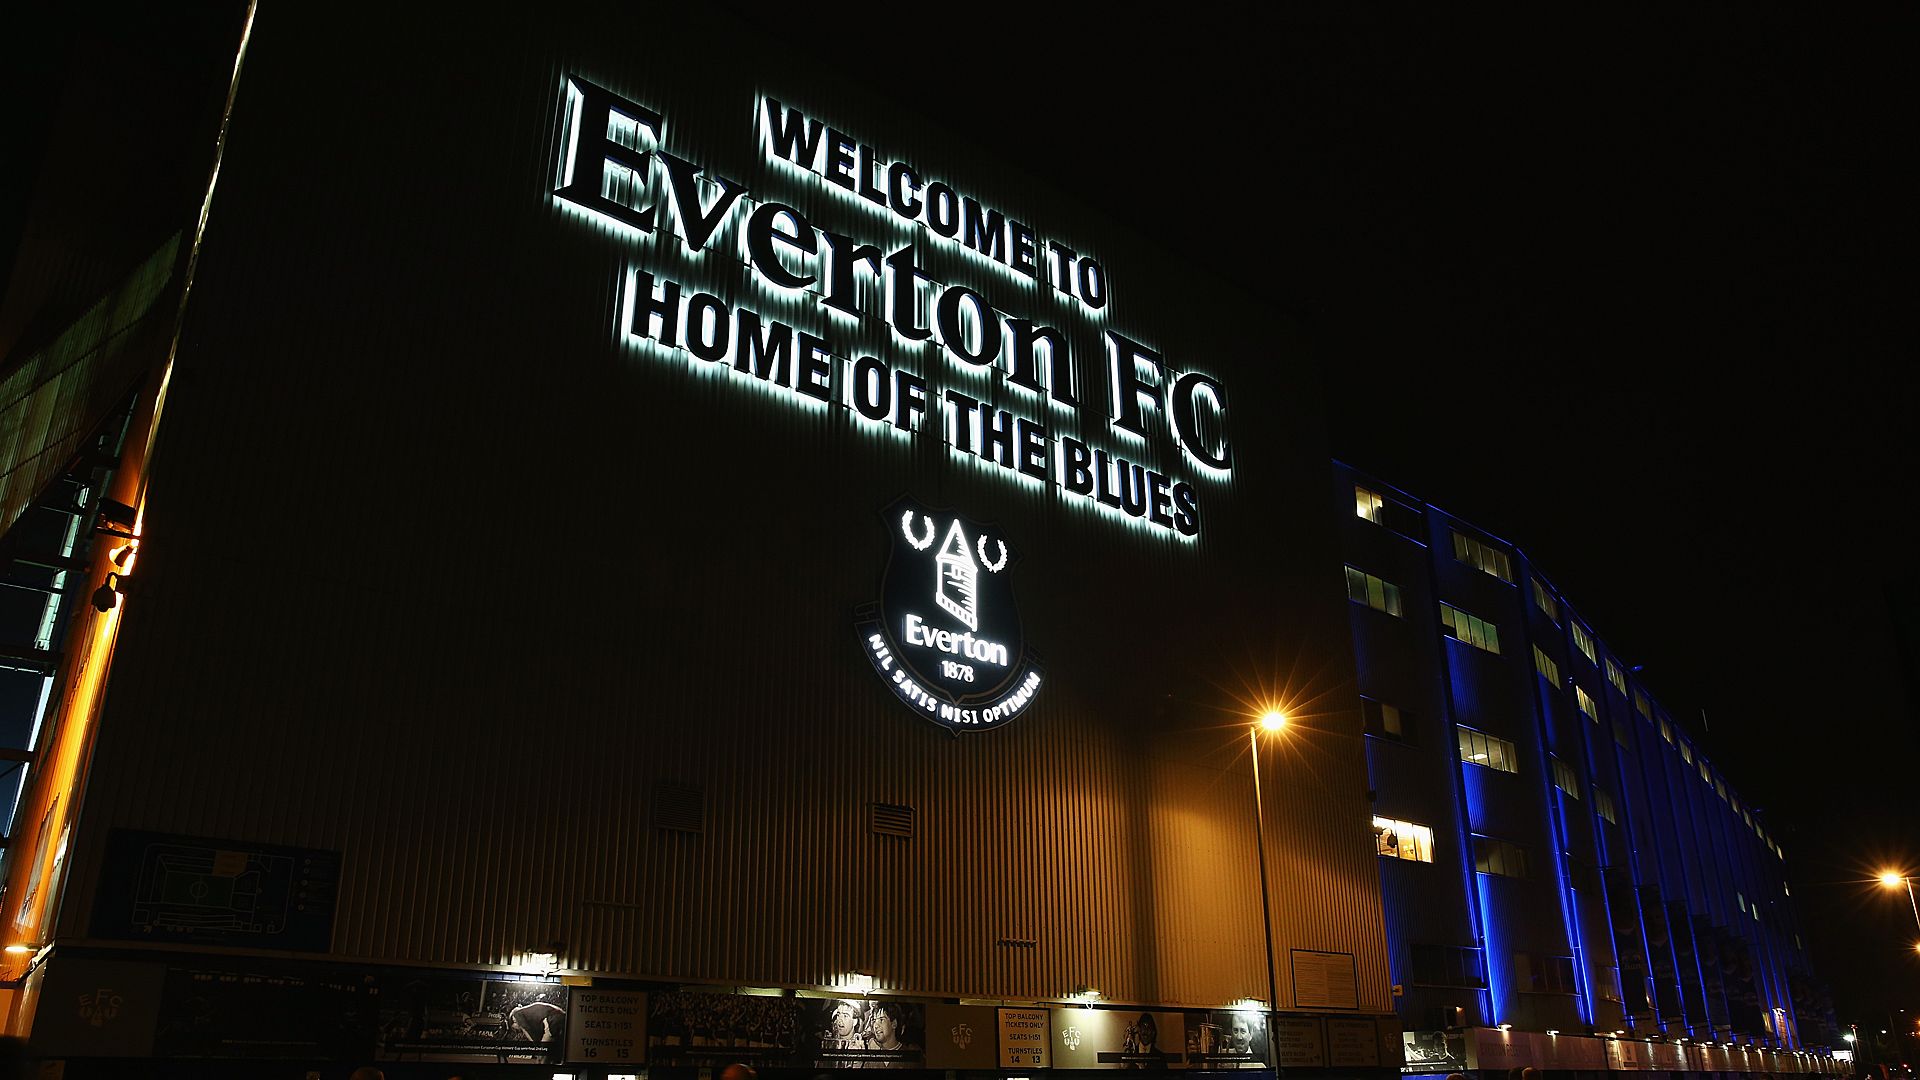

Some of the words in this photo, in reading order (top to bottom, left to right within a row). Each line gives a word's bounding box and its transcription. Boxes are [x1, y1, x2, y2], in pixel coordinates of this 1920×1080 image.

[765, 97, 1037, 280] WELCOME
[1049, 239, 1107, 309] TO
[553, 73, 1079, 410] Everton
[1106, 329, 1232, 470] FC
[631, 269, 832, 402] HOME
[852, 356, 927, 432] OF
[945, 389, 1049, 481] THE
[1062, 436, 1200, 536] BLUES
[905, 613, 1008, 666] Everton
[941, 660, 974, 682] 1878
[868, 633, 895, 671] NIL
[892, 669, 938, 712] SATIS
[941, 704, 979, 724] NISI
[982, 671, 1041, 723] OPTIMUM
[581, 994, 597, 1003] TOP
[600, 996, 639, 1004] BALCONY
[580, 1005, 615, 1014] TICKETS
[617, 1007, 639, 1015] ONLY
[584, 1021, 611, 1029] SEATS
[581, 1038, 633, 1047] TURNSTILES
[584, 1047, 597, 1058] 16
[617, 1048, 629, 1058] 15
[1008, 1047, 1043, 1055] TURNSTILES
[1011, 1055, 1020, 1064] 14
[1032, 1055, 1041, 1064] 13
